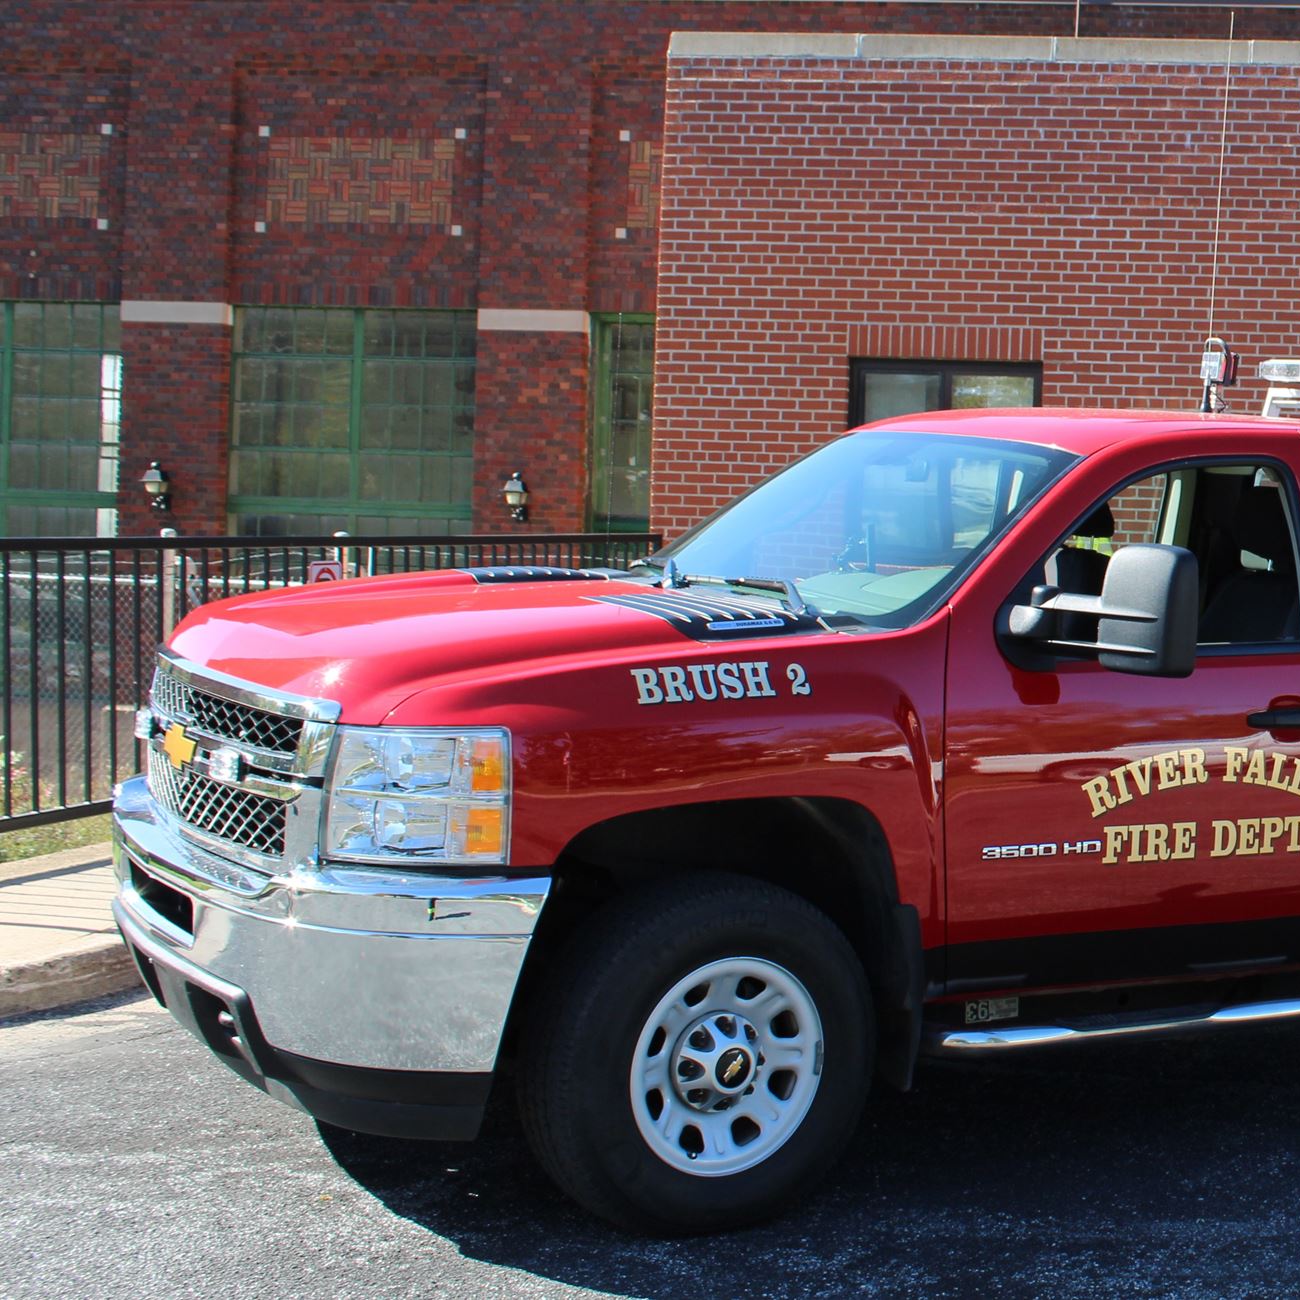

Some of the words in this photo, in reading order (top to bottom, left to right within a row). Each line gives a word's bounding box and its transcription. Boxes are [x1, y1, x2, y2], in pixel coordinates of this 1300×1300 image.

[630, 661, 776, 704] BRUSH
[786, 663, 812, 696] 2
[1081, 747, 1209, 818] RIVER
[982, 843, 1057, 859] 3500
[1063, 840, 1102, 854] HD
[1101, 822, 1197, 864] FIRE
